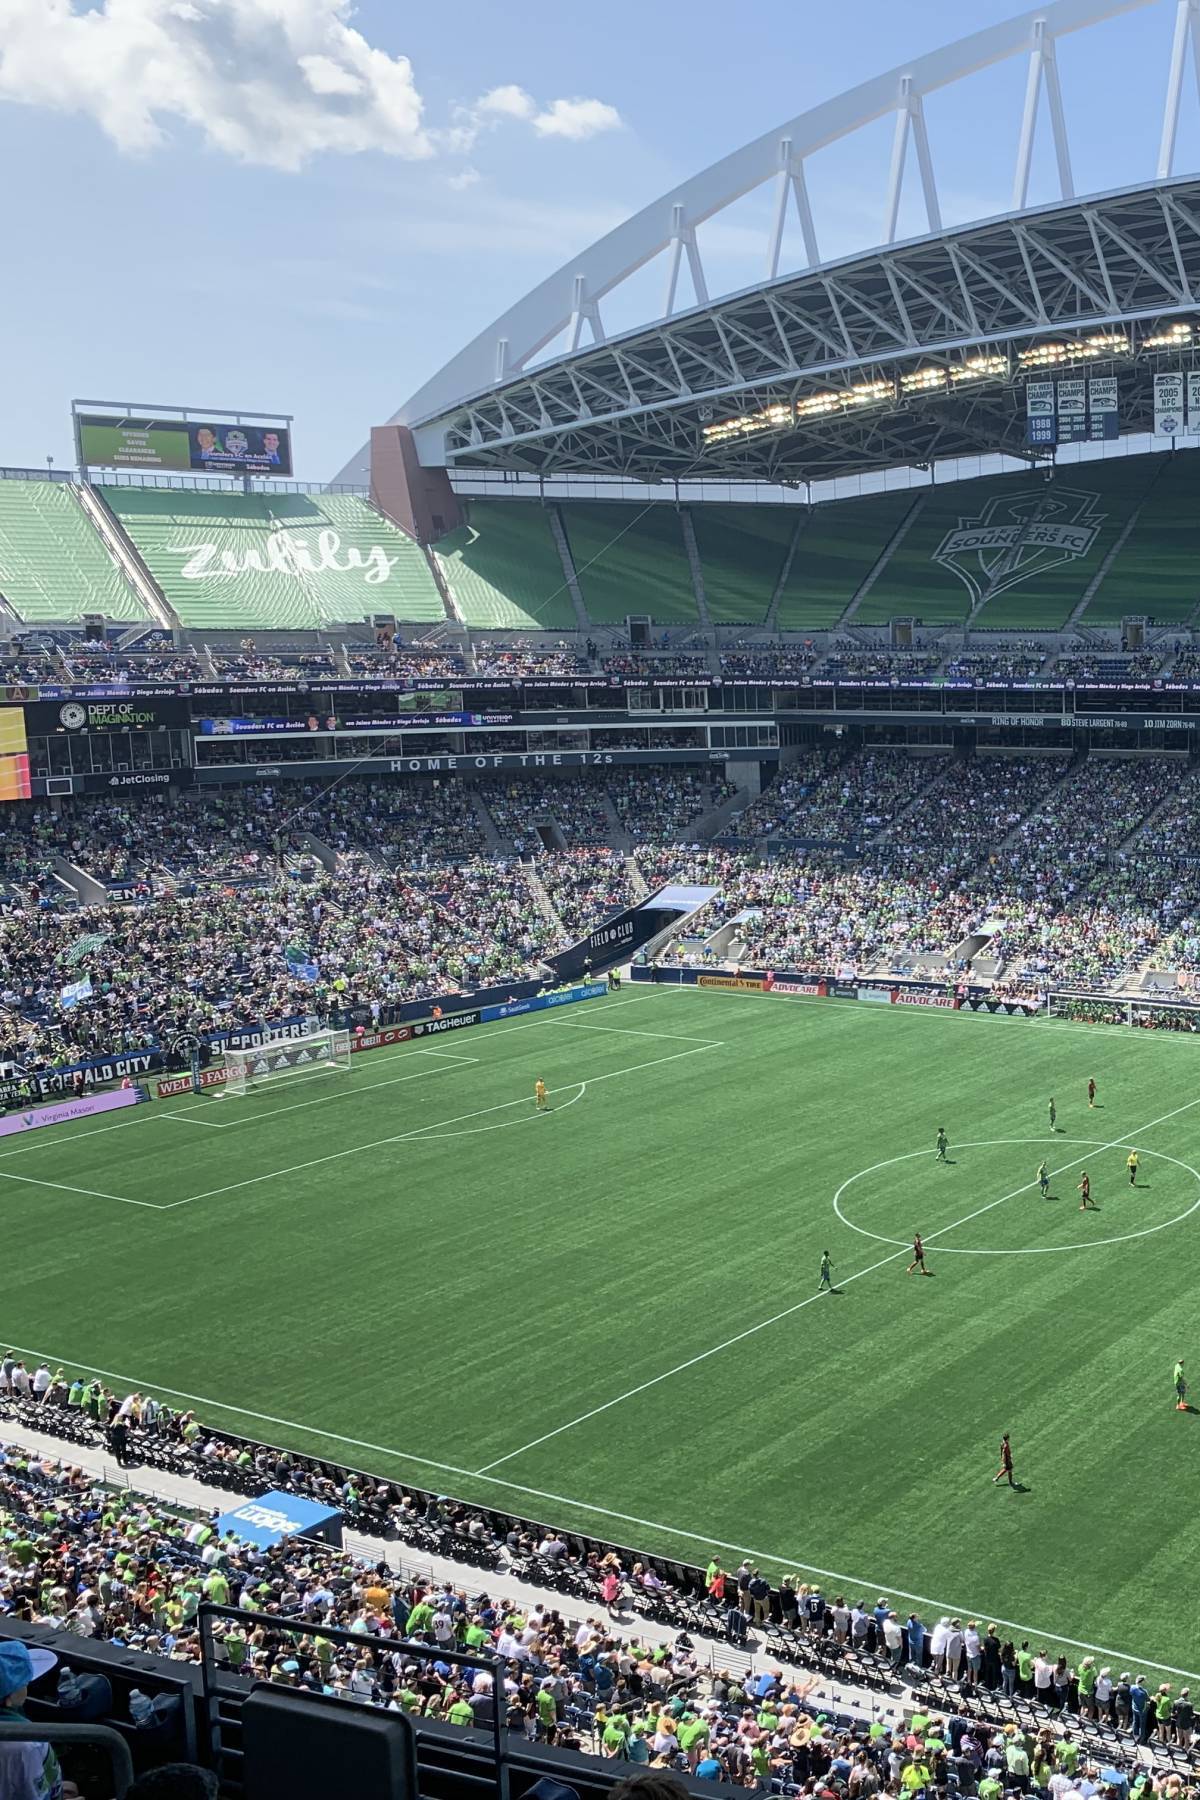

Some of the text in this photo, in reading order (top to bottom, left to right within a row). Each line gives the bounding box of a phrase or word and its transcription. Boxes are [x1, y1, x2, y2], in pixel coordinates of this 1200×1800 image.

[1028, 391, 1053, 399] CHAMPS
[1059, 388, 1085, 397] CHAMPS
[1090, 387, 1117, 396] CHAMPS
[1159, 388, 1179, 398] 2005
[1162, 398, 1176, 406] NFC
[1032, 431, 1051, 440] 1999
[1061, 534, 1085, 547] FC
[194, 686, 224, 694] Sábados
[88, 704, 134, 716] DEPT OF
[89, 712, 154, 725] IMAGINATION
[435, 716, 462, 725] Sábados
[992, 716, 1044, 726] RING OF HONOR
[1072, 719, 1089, 727] STEVE
[1090, 719, 1114, 727] LARGENT
[1144, 720, 1154, 728] 10
[390, 753, 613, 772] HOME OF THE 12s
[120, 774, 170, 786] JetClosing
[590, 933, 610, 949] FIELD
[617, 921, 634, 938] CLUB
[700, 976, 739, 987] Continental
[772, 982, 817, 994] ADVOCARE
[897, 995, 954, 1008] ADVOCARE
[116, 1055, 152, 1076] CITY
[206, 1064, 248, 1084] FARGO
[41, 1105, 95, 1123] Virginia Mason
